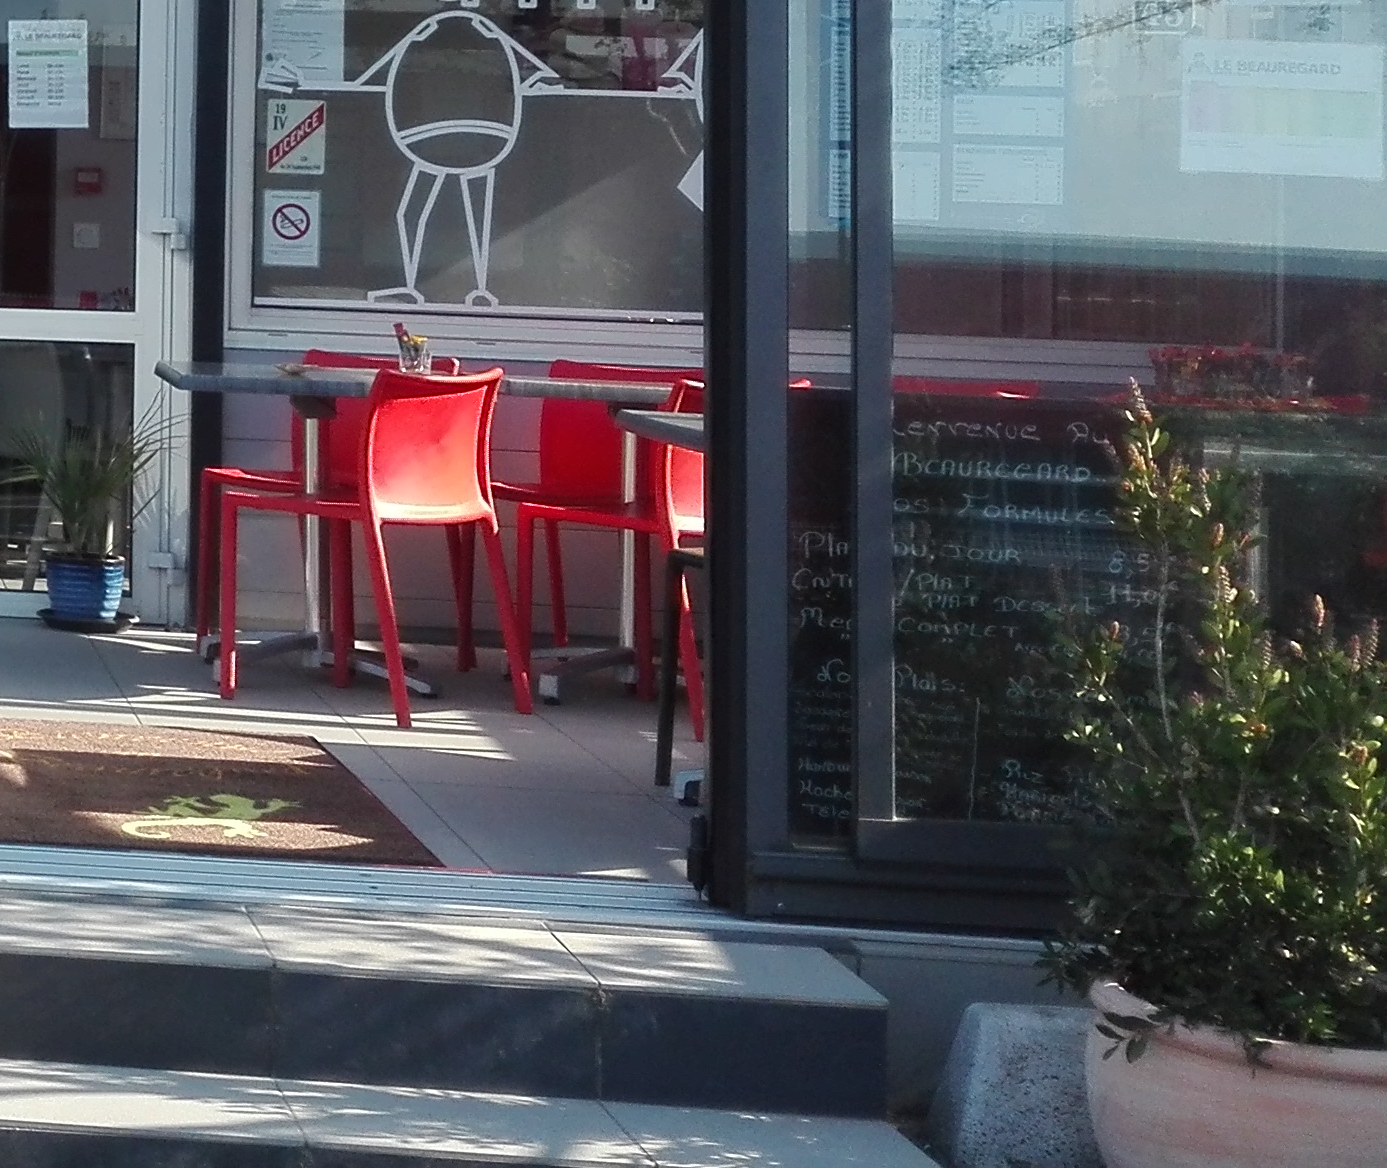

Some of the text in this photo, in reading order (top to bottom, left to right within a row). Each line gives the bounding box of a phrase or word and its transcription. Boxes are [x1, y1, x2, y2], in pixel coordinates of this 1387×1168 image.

[1237, 59, 1342, 76] BEAUREGARD
[271, 110, 320, 164] LICENCE
[893, 497, 930, 514] OS
